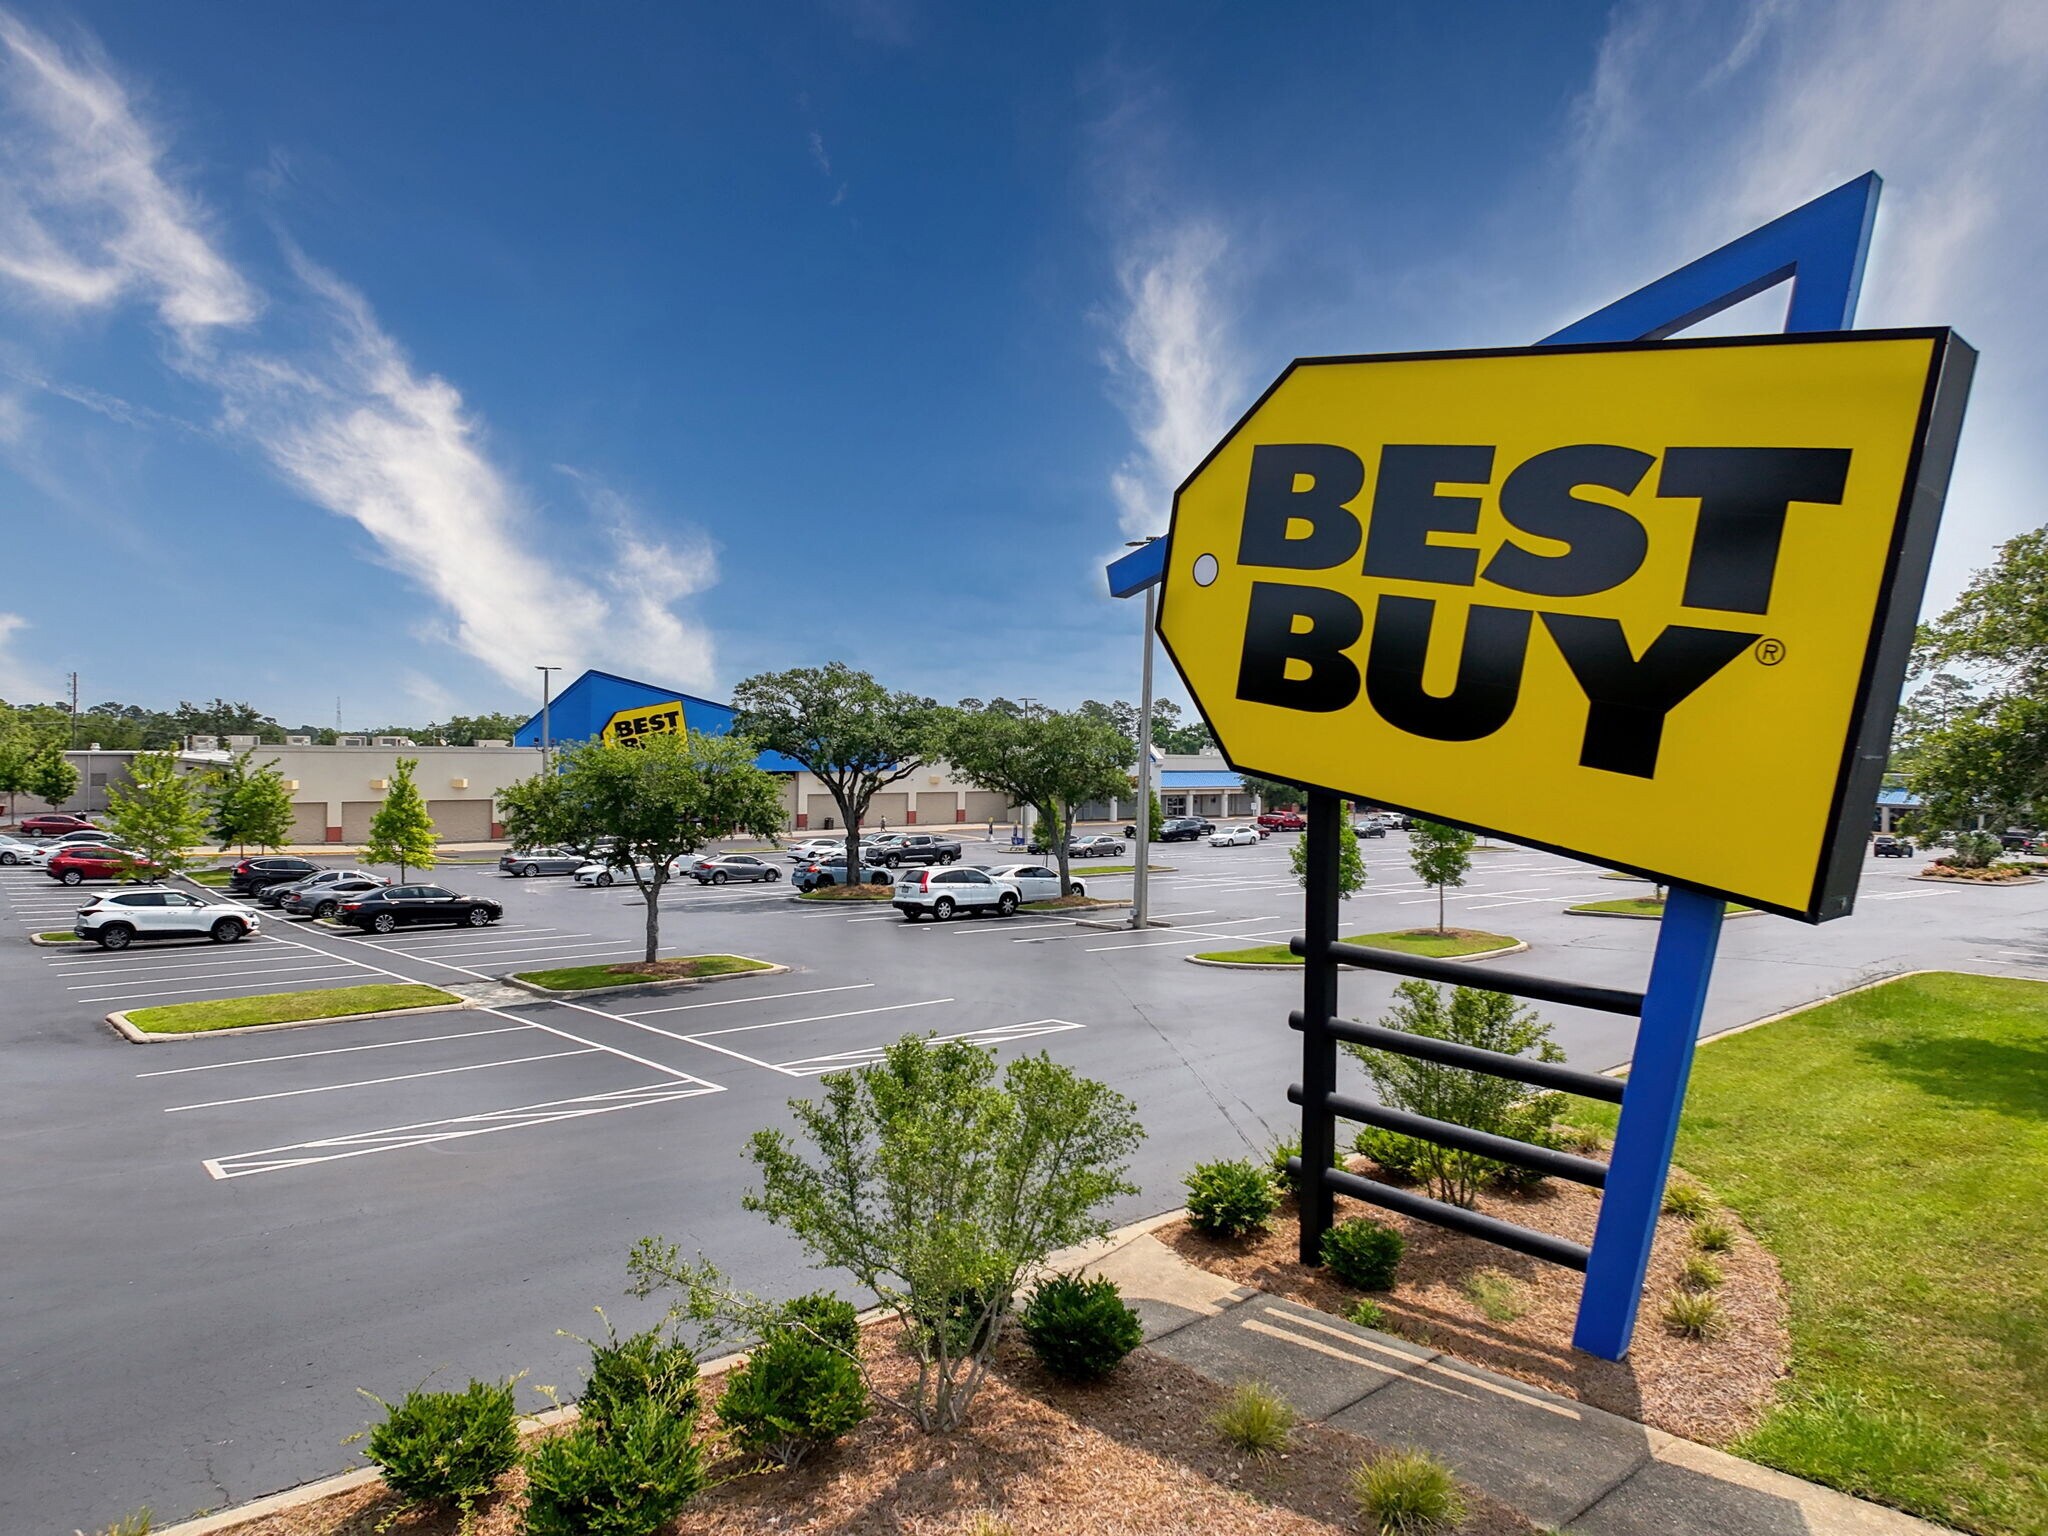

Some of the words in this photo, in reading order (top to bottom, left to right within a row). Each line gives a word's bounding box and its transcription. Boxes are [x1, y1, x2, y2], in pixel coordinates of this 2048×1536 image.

[1237, 444, 1853, 615] BEST
[614, 711, 679, 738] BEST
[1236, 581, 1763, 779] BUY
